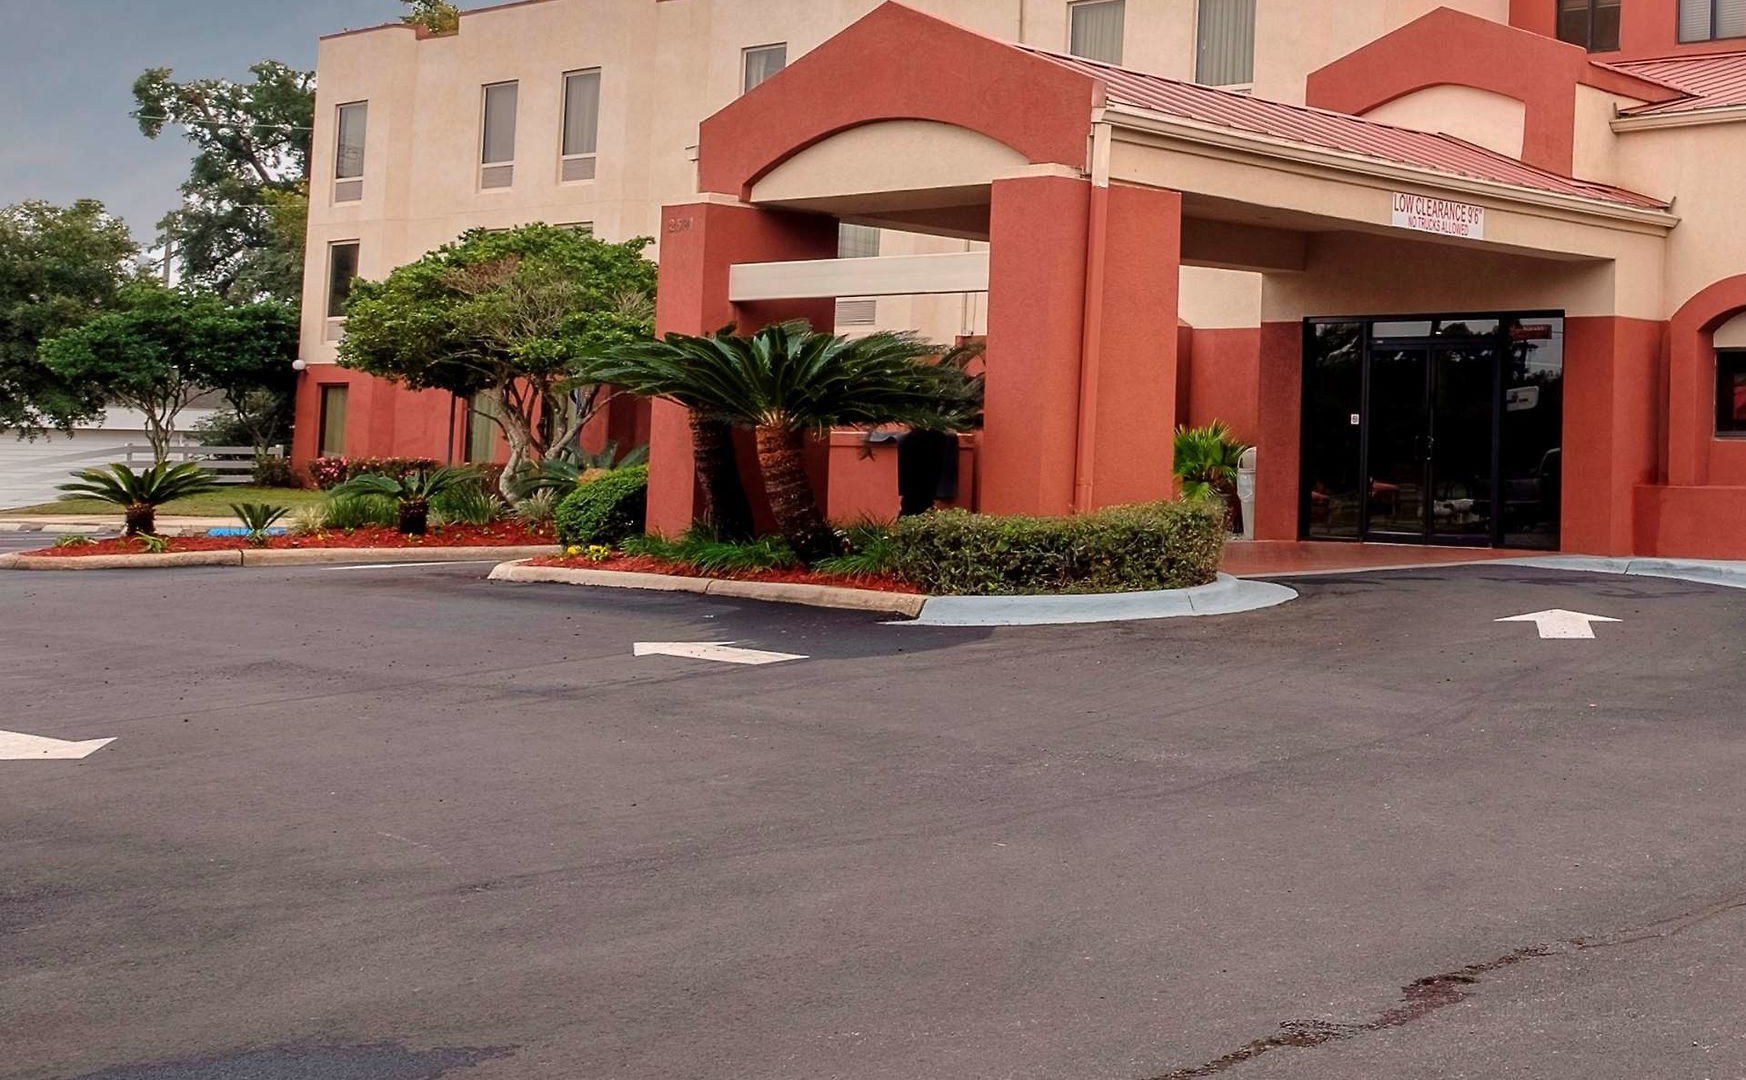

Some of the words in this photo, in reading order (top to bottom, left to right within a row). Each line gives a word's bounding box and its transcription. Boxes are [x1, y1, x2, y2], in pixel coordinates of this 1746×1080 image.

[1394, 194, 1414, 213] LOW
[1415, 197, 1466, 222] CLEARANCE
[1408, 215, 1418, 228] NO
[1441, 220, 1469, 236] ALLOWED
